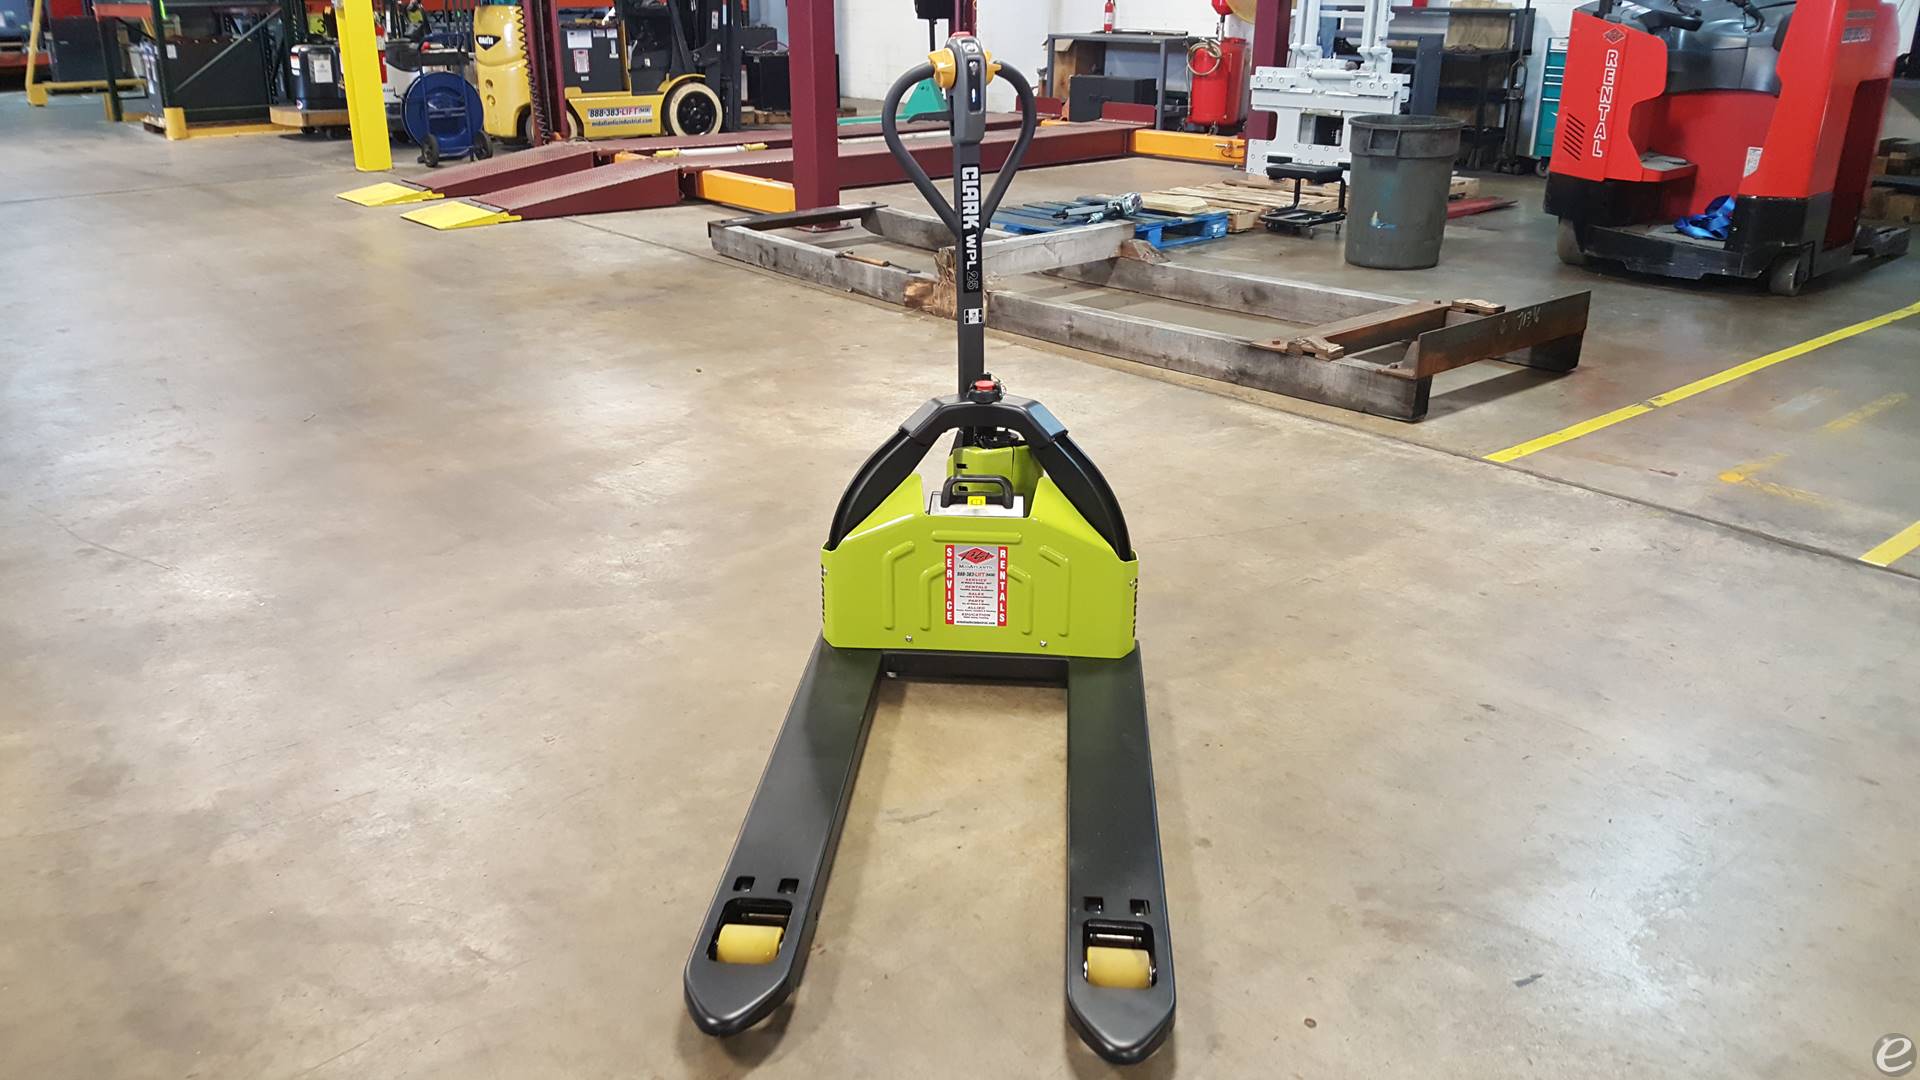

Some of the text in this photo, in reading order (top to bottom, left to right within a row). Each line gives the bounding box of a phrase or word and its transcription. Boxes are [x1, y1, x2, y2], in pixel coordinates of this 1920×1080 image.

[1592, 49, 1618, 157] RENTAL
[961, 166, 980, 290] CLARK WPL 25
[999, 549, 1007, 622] RENTALS
